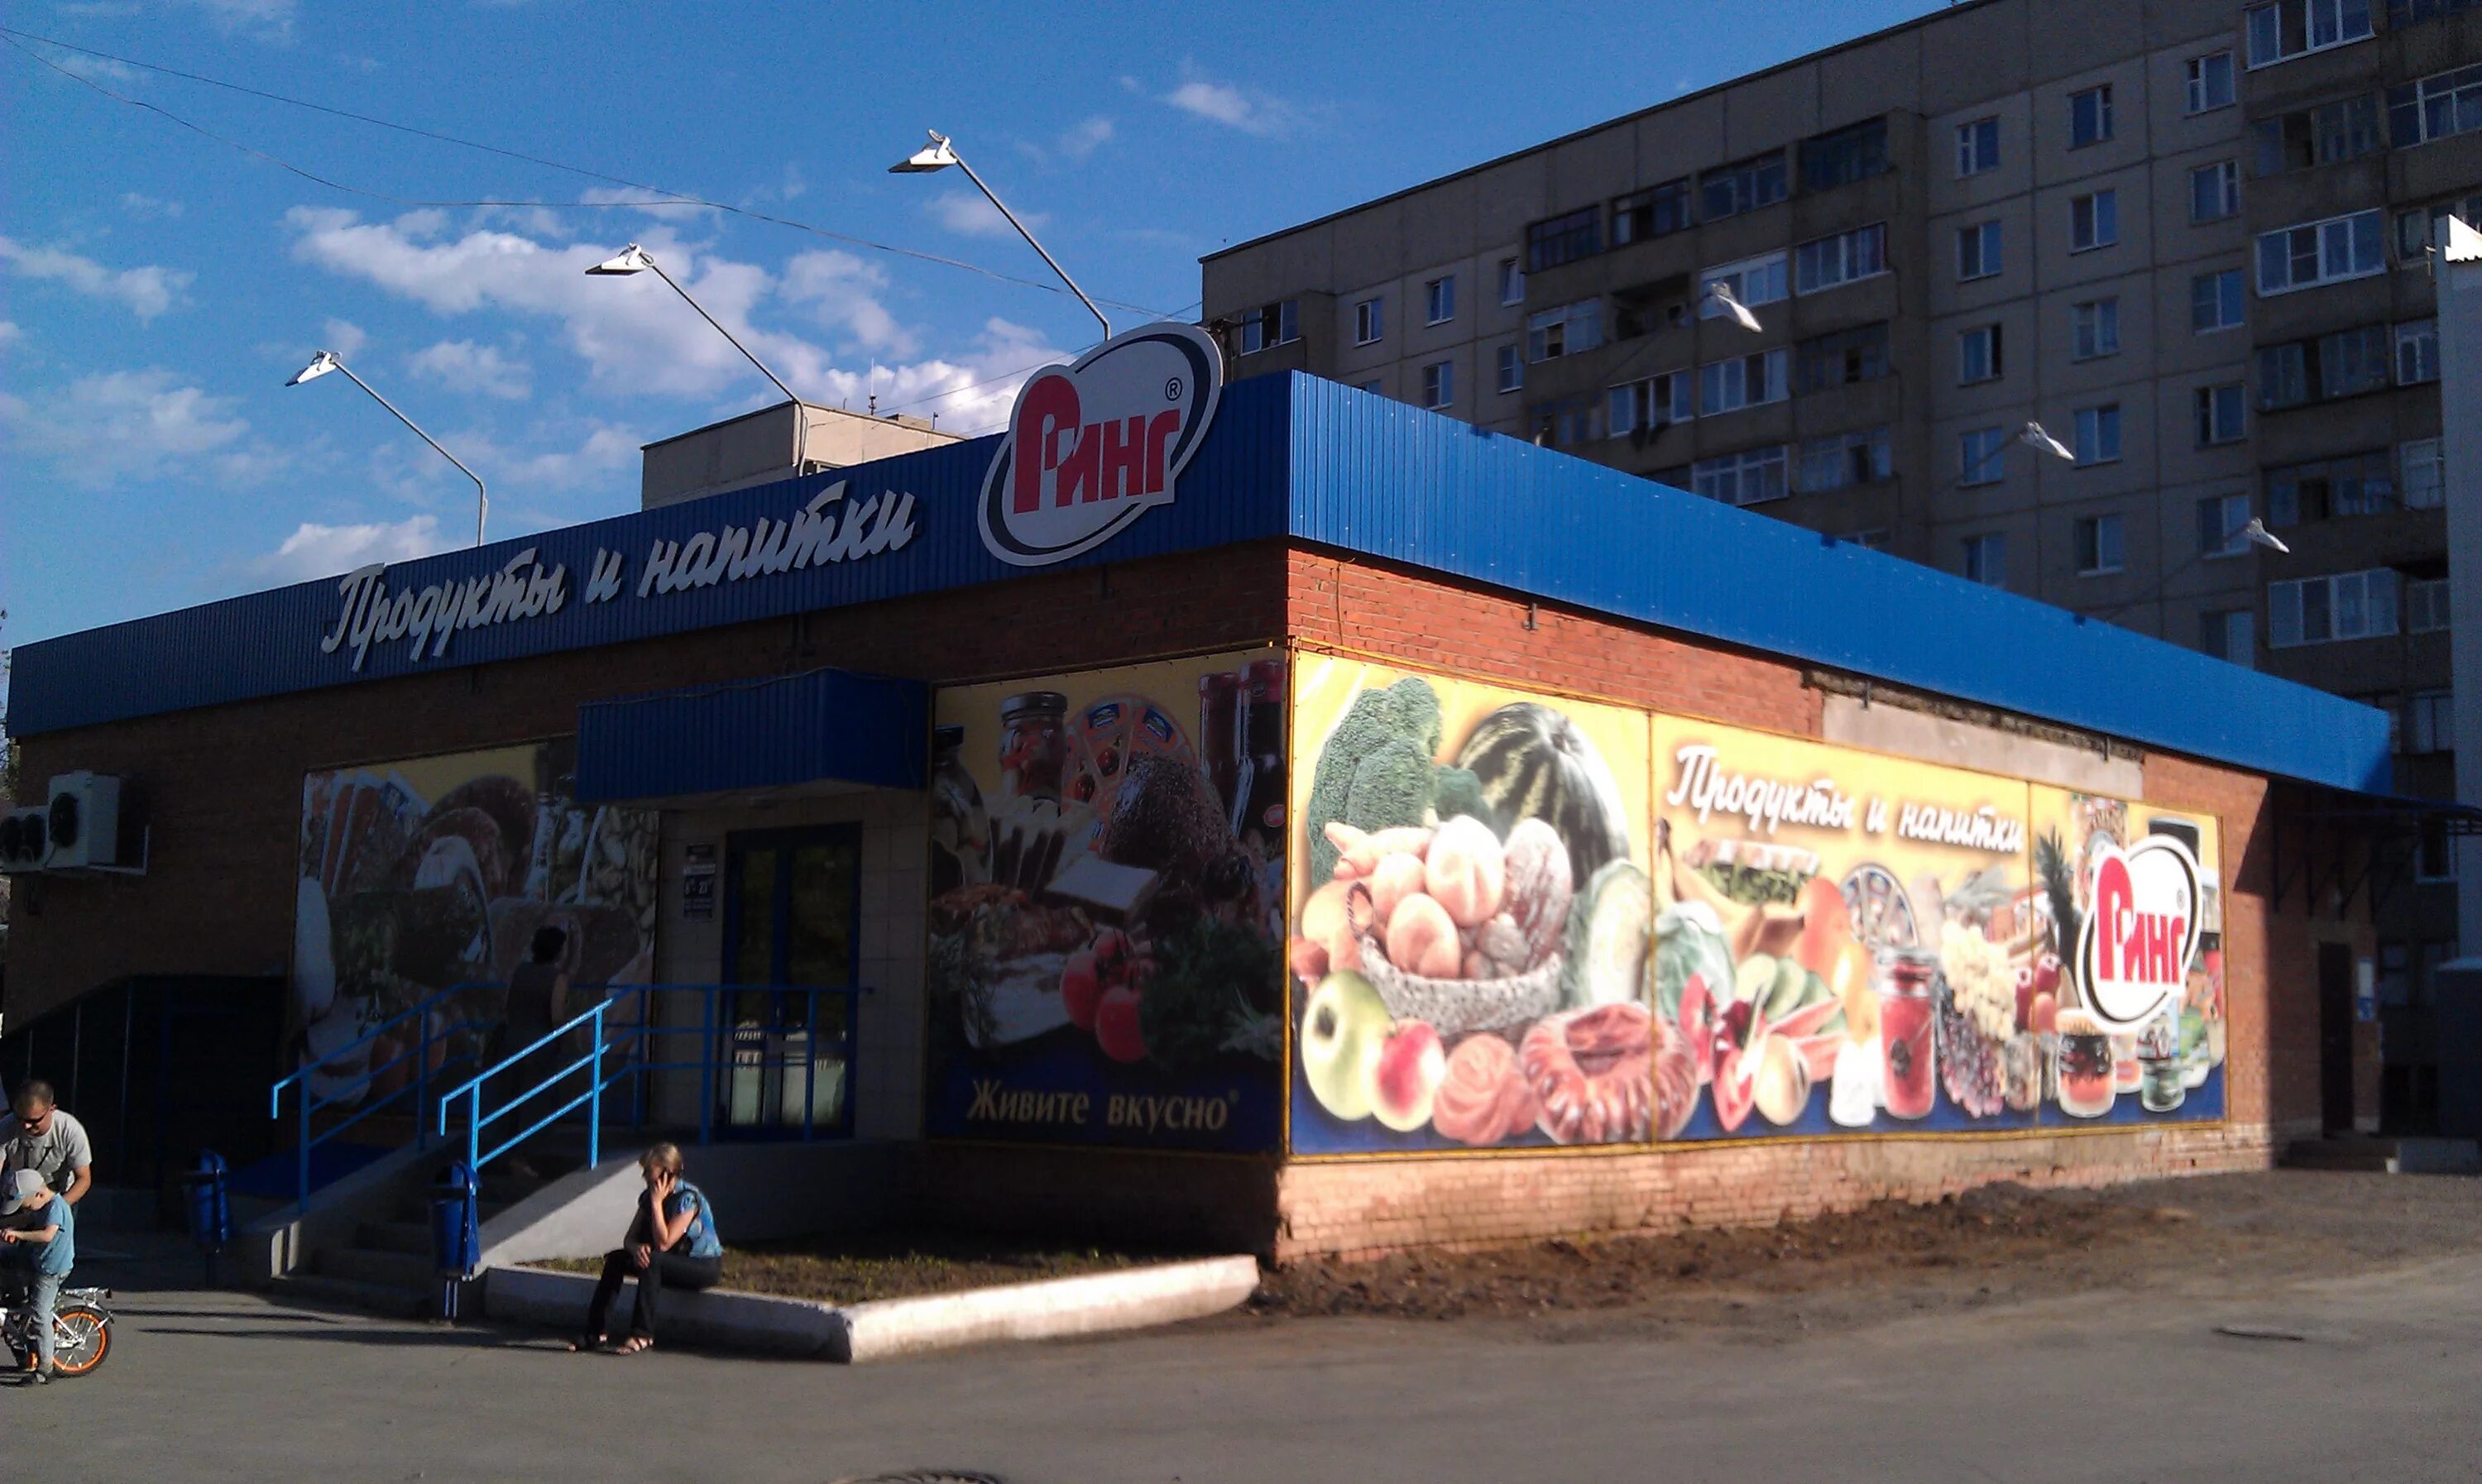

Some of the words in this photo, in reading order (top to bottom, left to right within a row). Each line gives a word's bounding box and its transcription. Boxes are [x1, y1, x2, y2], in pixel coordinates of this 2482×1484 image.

[321, 548, 567, 671] Продукты
[586, 547, 622, 601] и
[638, 481, 915, 598] напитки
[1667, 745, 1855, 831] Продукты
[1866, 799, 1888, 834] и
[1899, 805, 2024, 853] напитки
[967, 1079, 1090, 1123] Живите
